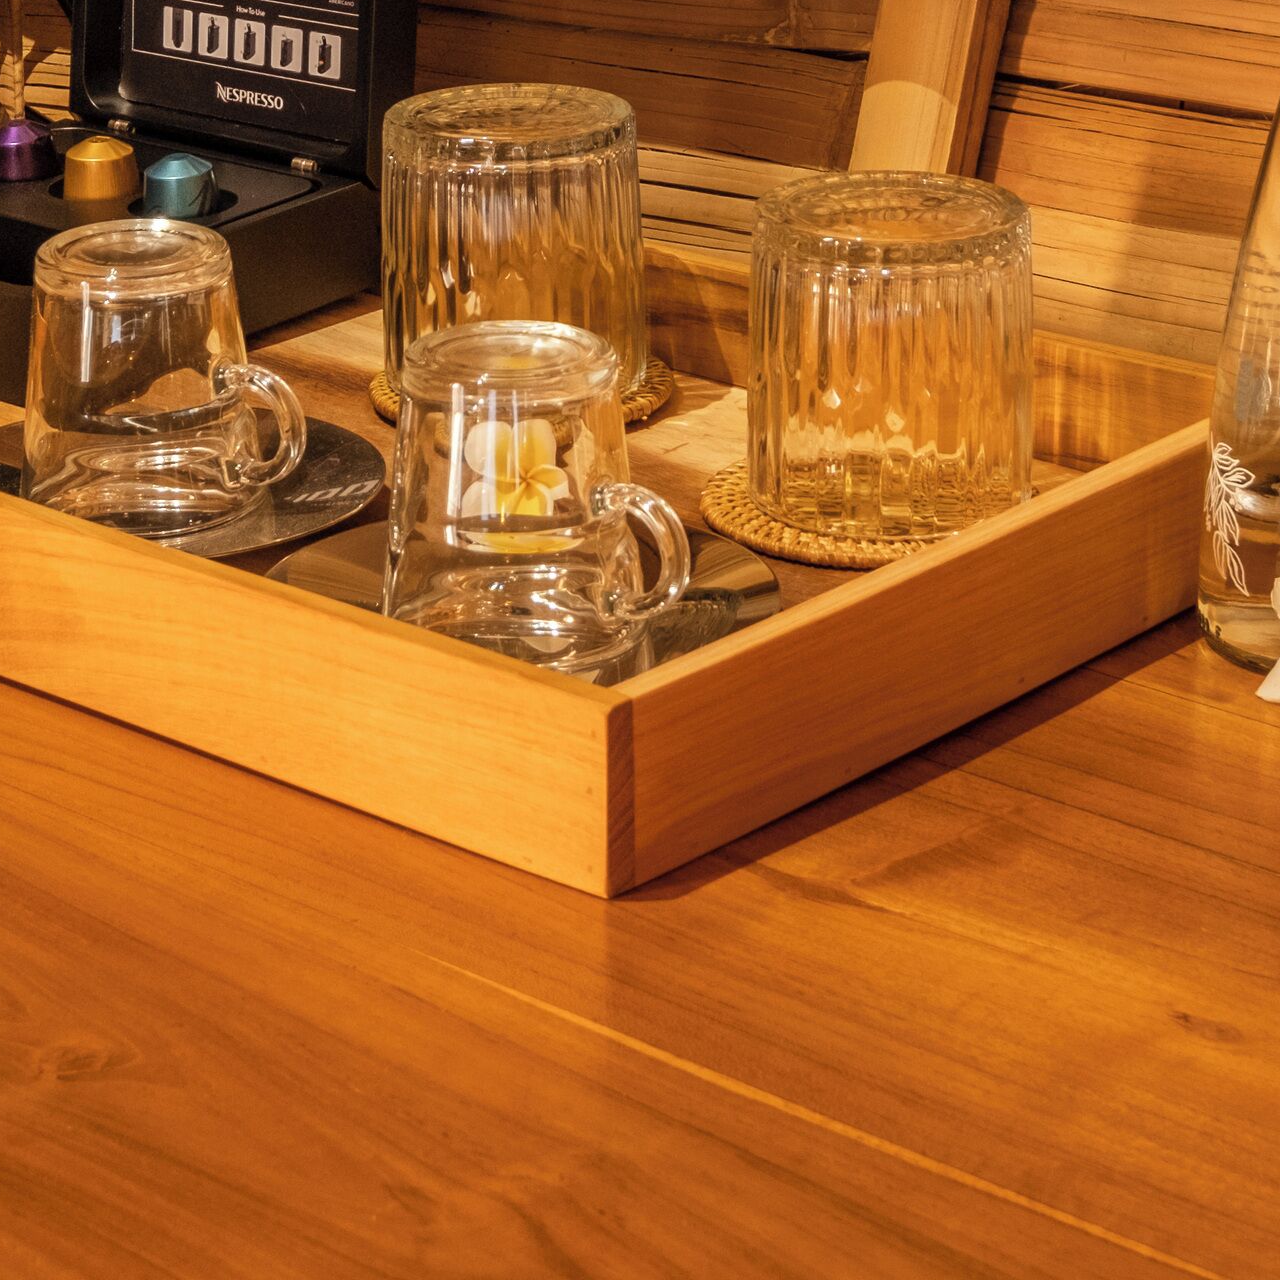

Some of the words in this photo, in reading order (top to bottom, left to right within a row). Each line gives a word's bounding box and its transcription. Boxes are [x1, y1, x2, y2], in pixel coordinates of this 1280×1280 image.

[236, 5, 248, 13] How
[255, 8, 266, 16] Use
[216, 81, 284, 110] NESPRESSO
